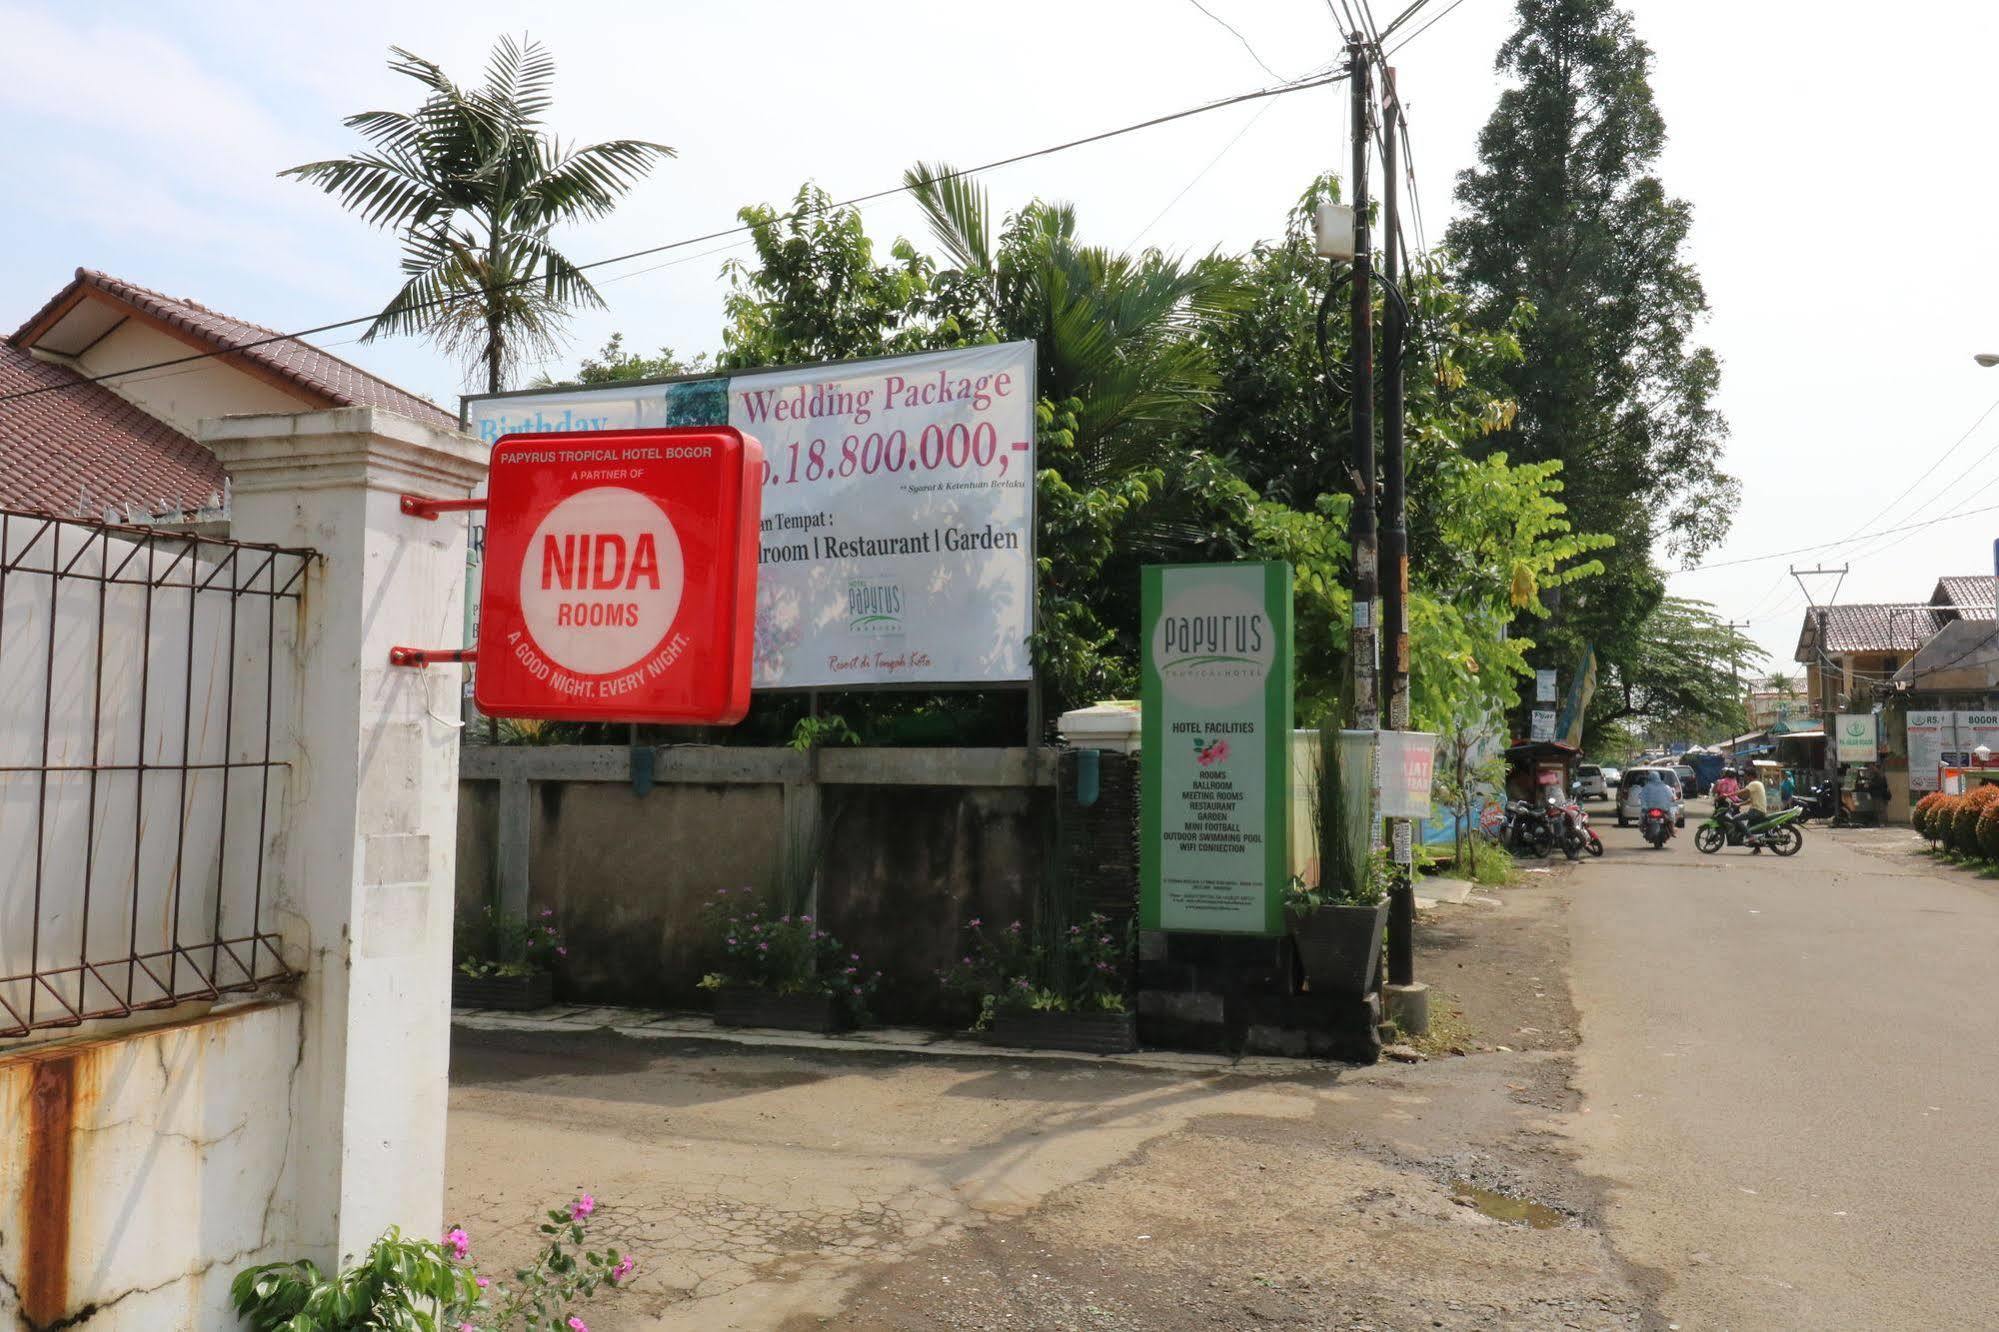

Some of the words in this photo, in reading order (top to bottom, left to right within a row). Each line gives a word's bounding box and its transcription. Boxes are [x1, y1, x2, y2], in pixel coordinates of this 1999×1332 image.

[741, 384, 874, 424] Wedding
[882, 370, 1011, 411] Package
[501, 451, 555, 464] PAPYRUS
[559, 449, 618, 462] TROPICAL
[622, 447, 662, 459] HOTEL
[666, 446, 712, 459] BOGOR
[571, 472, 578, 480] A
[580, 469, 627, 480] PARTNER
[629, 468, 644, 478] OF
[945, 480, 988, 491] Ketentuan
[775, 511, 826, 532] Tempat
[758, 543, 809, 564] lroom
[824, 531, 930, 559] Restaurant
[945, 525, 1018, 551] Garden
[541, 533, 661, 590] NIDA
[848, 585, 901, 615] papyrus
[557, 602, 639, 628] ROOMS
[1165, 615, 1262, 654] papyrus
[508, 631, 521, 646] A
[515, 643, 550, 681] GOOD
[549, 672, 596, 698] NIGHT.
[600, 669, 646, 697] EVERY
[647, 632, 690, 679] NIGHT.
[1224, 669, 1263, 678] HOTEL
[1968, 715, 1998, 724] BOGOR
[1172, 722, 1202, 734] HOTEL
[1204, 722, 1254, 734] FACILITIES
[1199, 771, 1227, 780] ROOMS
[1192, 781, 1233, 790] BALLROOM
[1181, 791, 1214, 800] MEETING
[1216, 792, 1244, 801] ROOMS
[1189, 802, 1236, 811] RESTAURANT
[1197, 812, 1228, 822] GARDEN
[1184, 822, 1203, 831] MINI
[1204, 823, 1241, 832] FOOTBALL
[1163, 832, 1198, 841] OUTDOOR
[1199, 833, 1241, 843] SWIMMING
[1243, 834, 1264, 843] POOL
[1179, 843, 1197, 852] WIFI
[1198, 844, 1245, 854] CONNECTION
